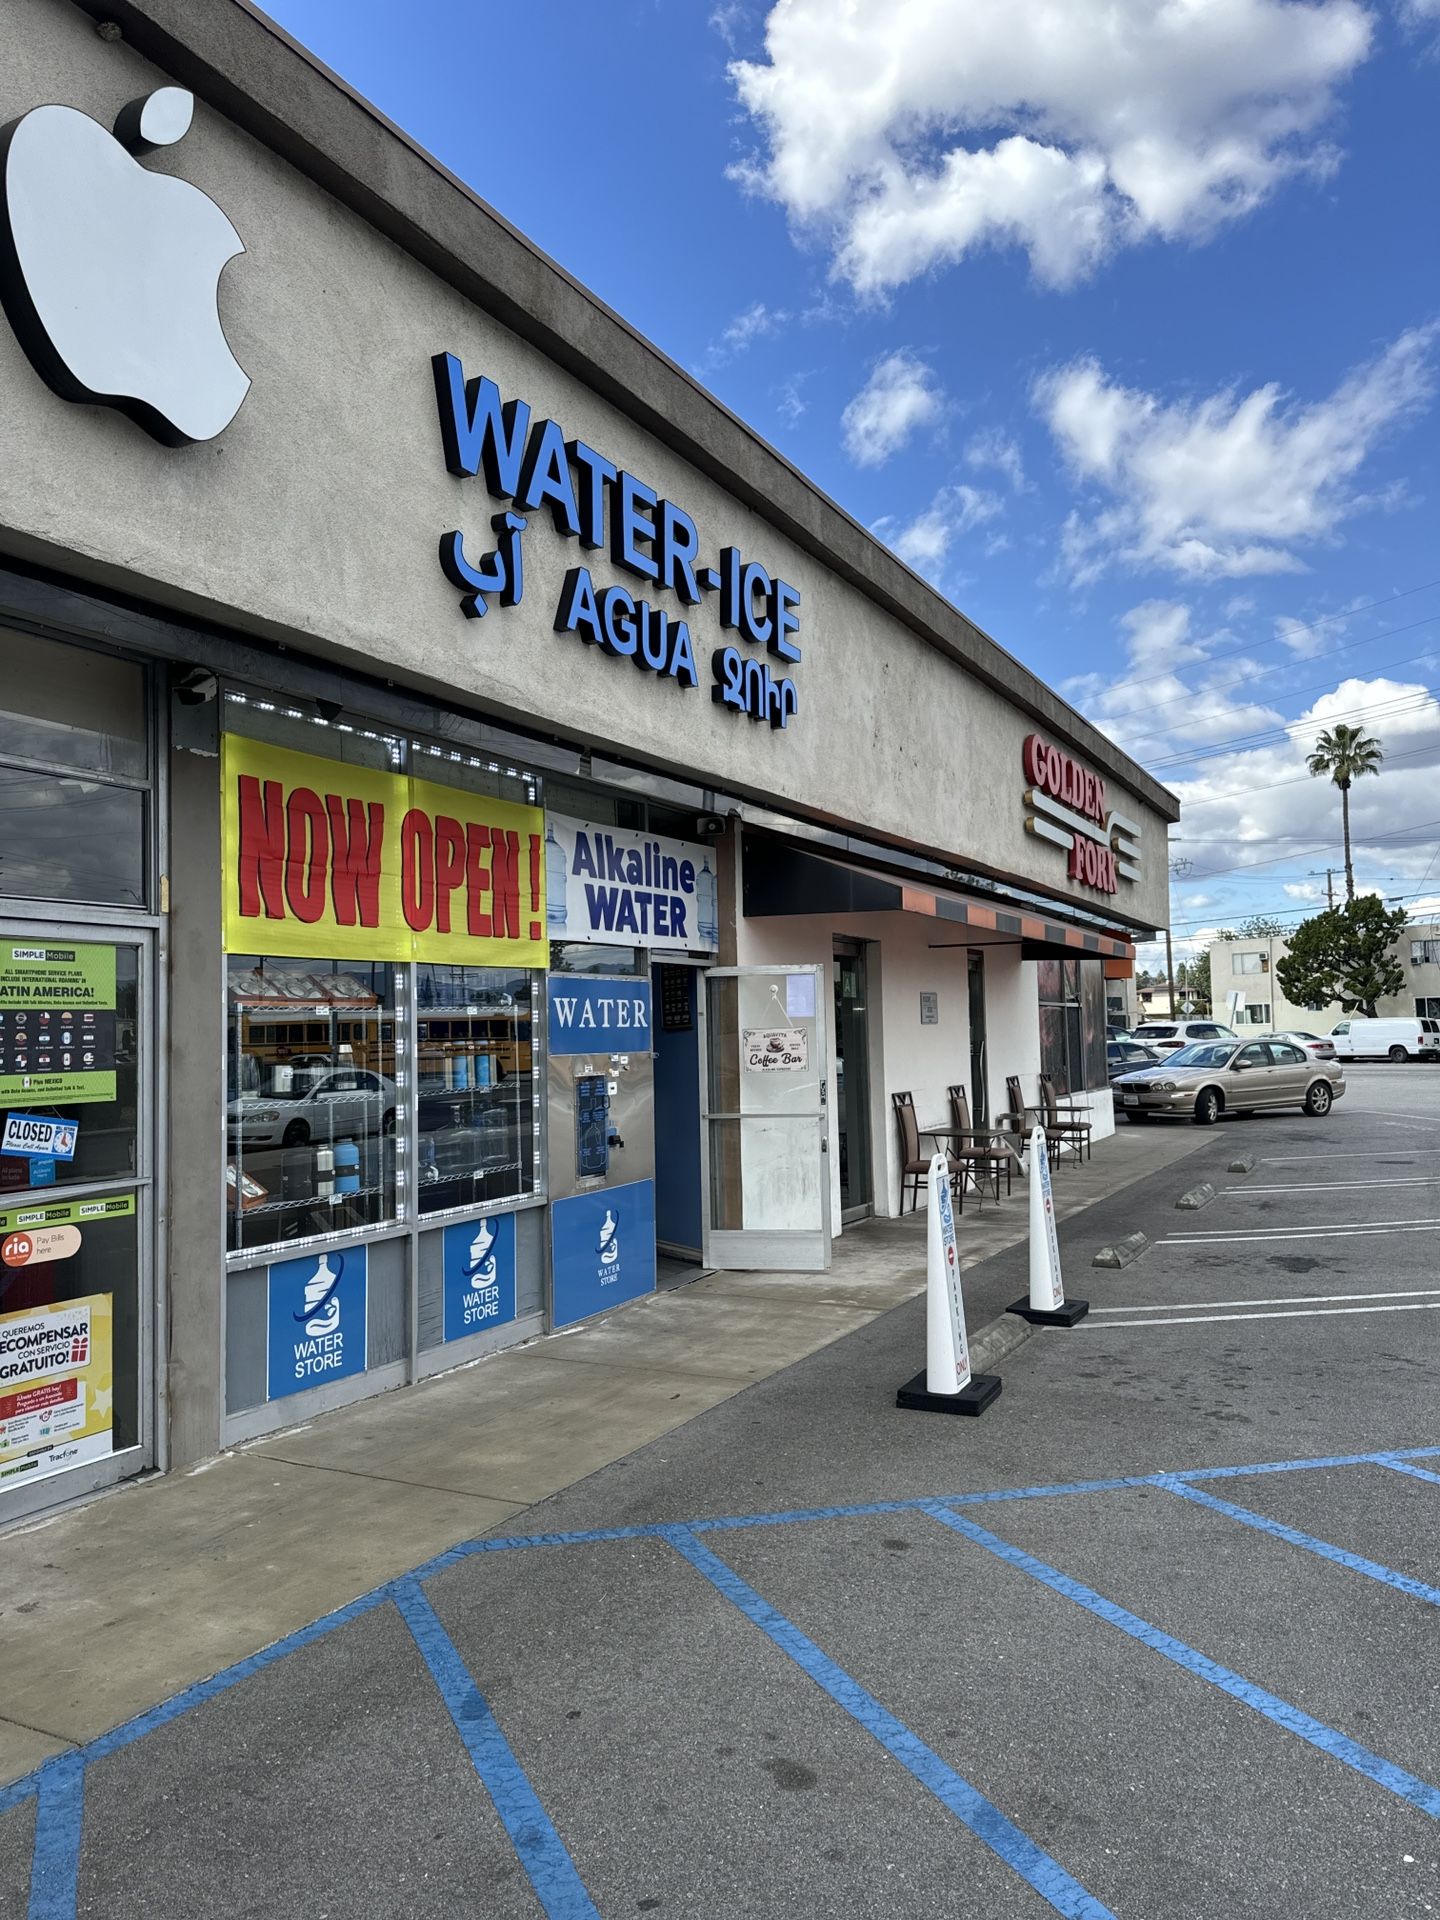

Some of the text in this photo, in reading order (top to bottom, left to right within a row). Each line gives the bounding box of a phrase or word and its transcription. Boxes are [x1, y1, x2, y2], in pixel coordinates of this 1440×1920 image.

[432, 352, 801, 664] WATER-ICE
[439, 510, 528, 619] آب
[554, 566, 698, 688] AGUA
[1023, 734, 1106, 824] GOLDEN
[238, 774, 542, 941] NOW OPEN!
[572, 831, 695, 893] Alkaline
[1068, 832, 1118, 894] FORK
[584, 883, 688, 938] WATER
[14, 950, 74, 960] SIMPLE Mobile
[0, 986, 94, 998] ATIN AMERICA!
[553, 998, 648, 1028] WATER
[750, 1053, 803, 1067] Coffee Bar
[9, 1120, 53, 1142] CLOSED
[5, 1140, 21, 1148] Please
[19, 1210, 70, 1222] SIMPLE Mobile
[81, 1202, 128, 1214] SIMPLE Mobile
[6, 1237, 29, 1256] ria
[36, 1234, 64, 1244] Pay Bills
[36, 1246, 52, 1255] here
[598, 1264, 620, 1277] WATER
[601, 1273, 618, 1287] STORE
[463, 1286, 499, 1308] WATER
[464, 1303, 499, 1324] STORE
[0, 1323, 88, 1354] ECOMPENSAR
[2, 1323, 45, 1339] QUEREMOS
[18, 1341, 70, 1360] CON SERVICIO
[294, 1333, 344, 1360] WATER
[295, 1352, 343, 1378] STORE
[32, 1387, 51, 1397] GRATIS
[49, 1449, 78, 1462] Tracfone
[1, 1465, 20, 1478] SIMPLE
